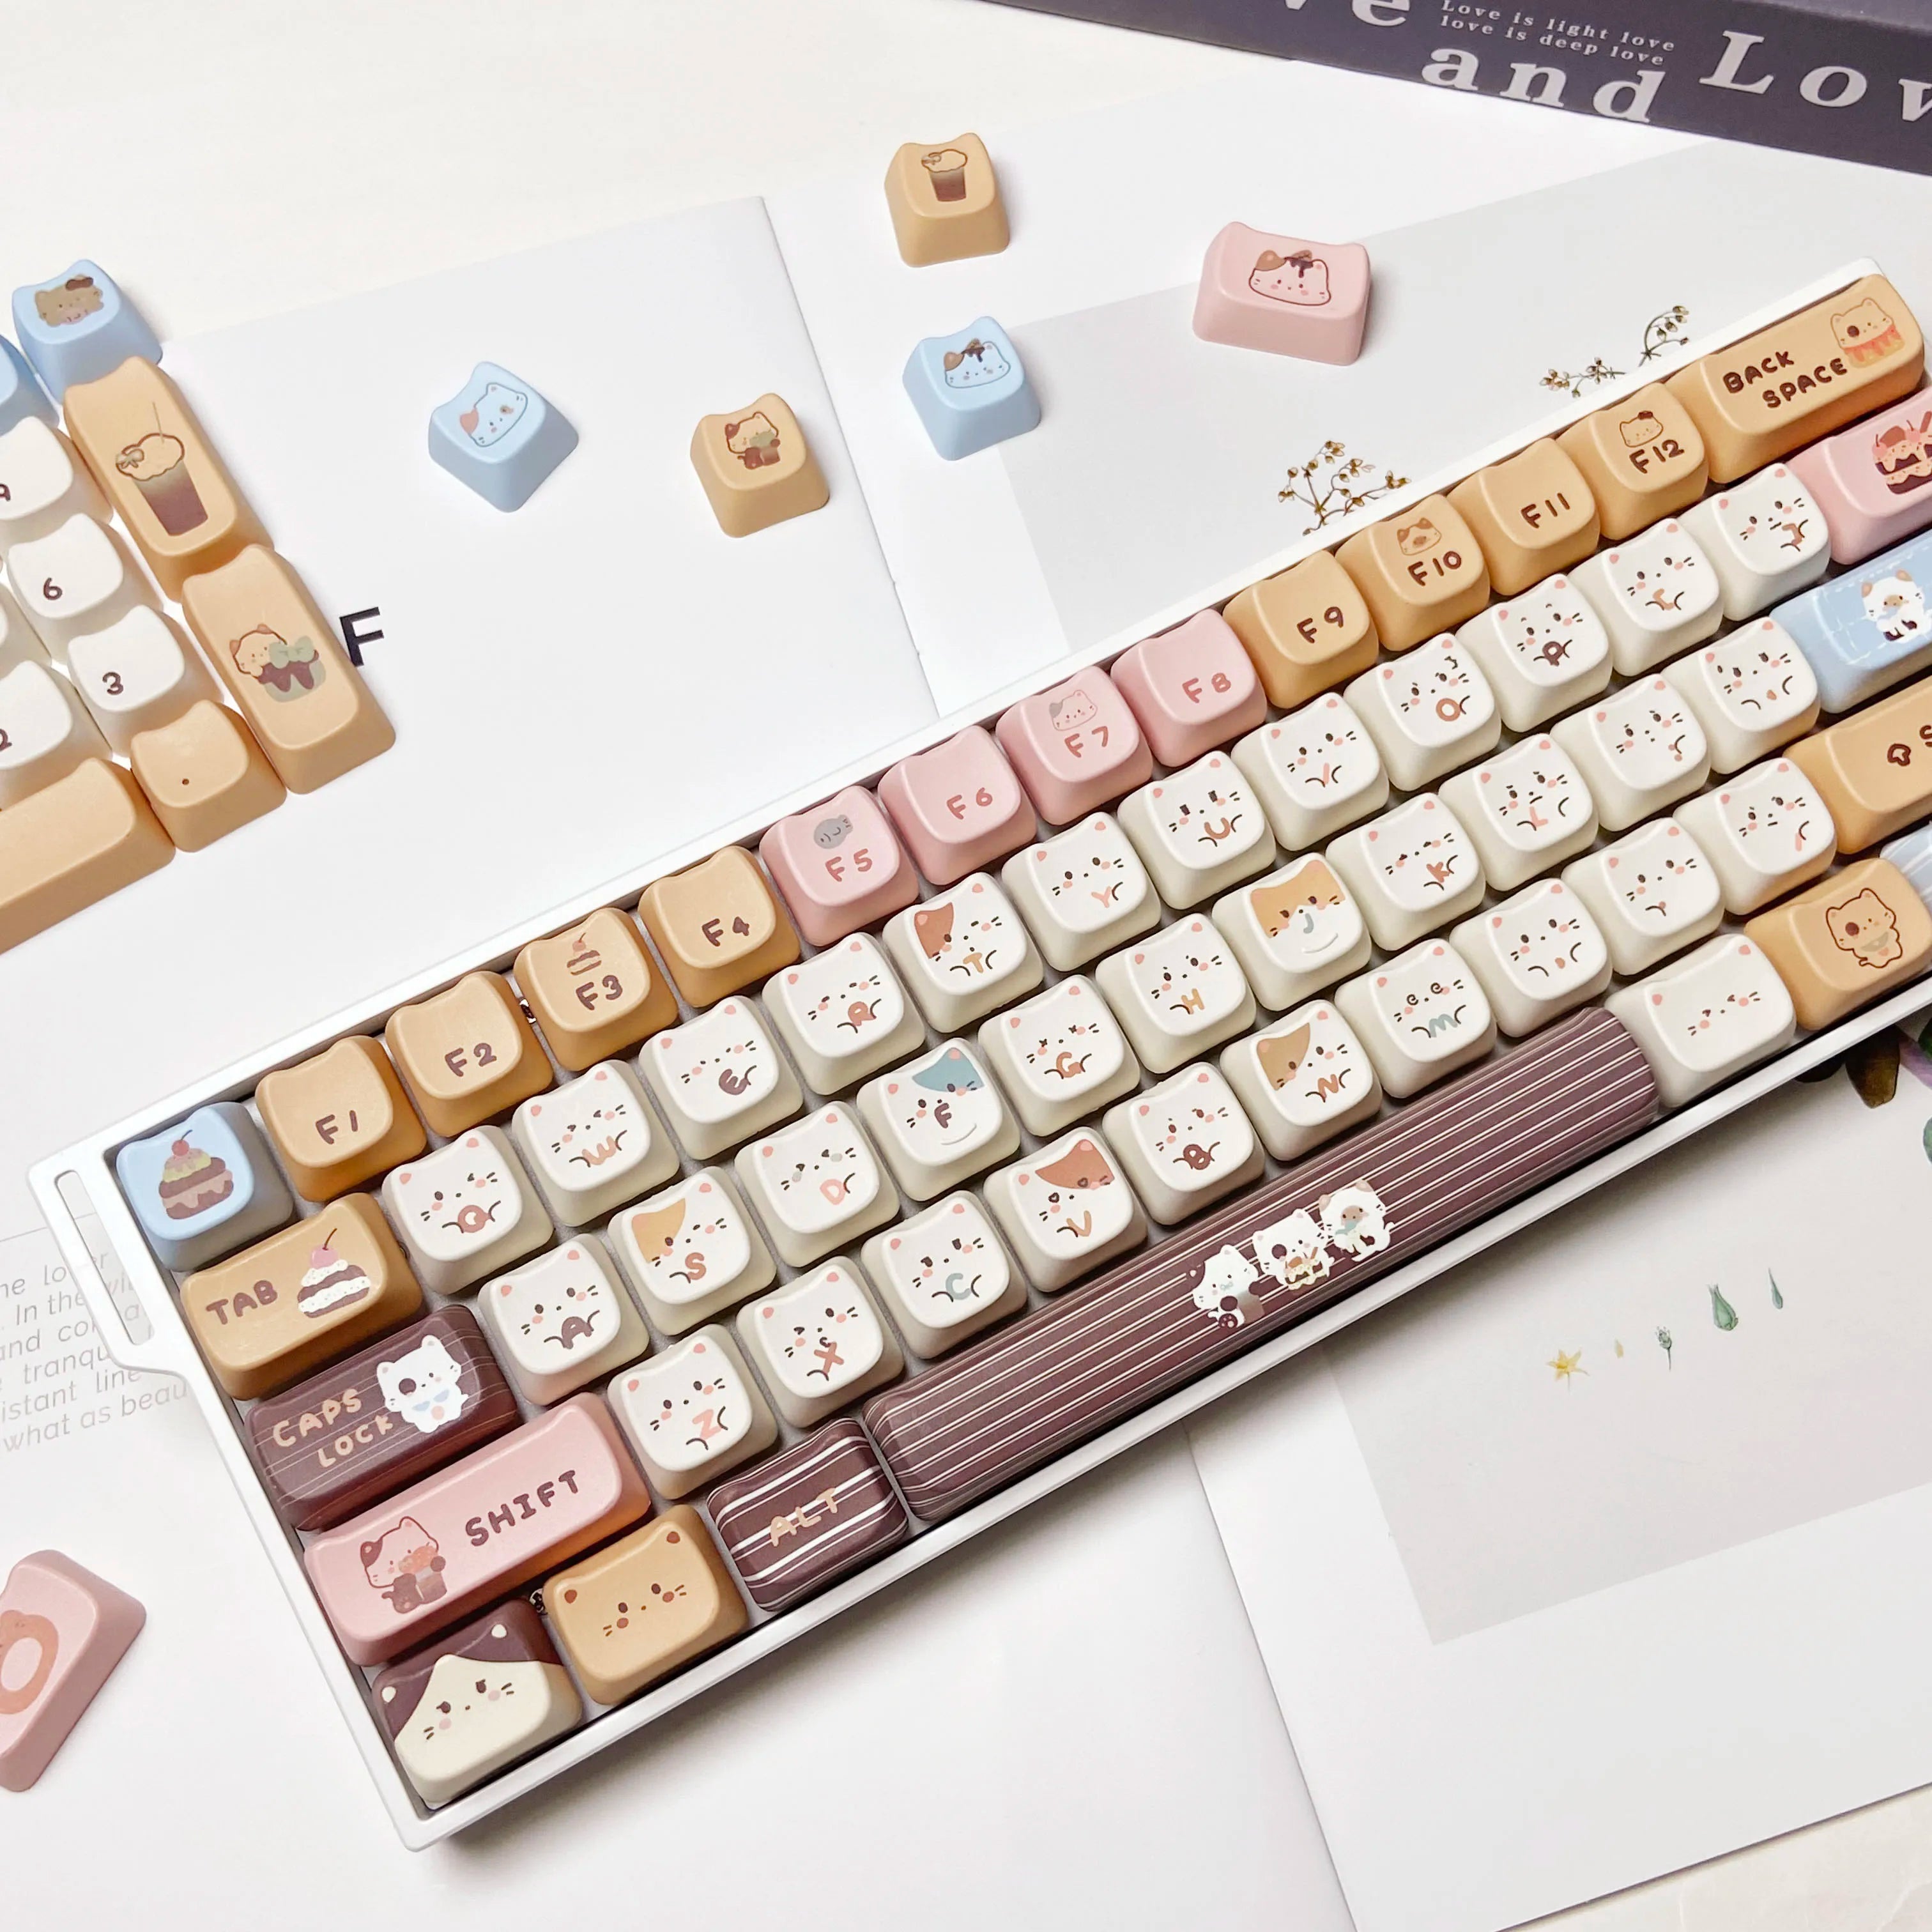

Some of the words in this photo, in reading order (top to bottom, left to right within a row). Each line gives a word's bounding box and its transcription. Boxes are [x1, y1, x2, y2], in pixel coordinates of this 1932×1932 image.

[1441, 0, 1500, 20] Love
[1513, 12, 1533, 26] is
[1546, 19, 1609, 40] light
[1621, 32, 1675, 51] love
[1441, 15, 1493, 34] love
[1505, 27, 1526, 41] is
[1540, 34, 1597, 56] deep
[1611, 46, 1664, 65] love
[1422, 49, 1665, 123] and
[1722, 351, 1794, 394] BACK
[1762, 358, 1848, 408] SPACE
[1629, 439, 1684, 474] F12
[1521, 493, 1570, 529] F11
[1407, 550, 1461, 586] F10
[43, 577, 63, 601] 6
[339, 606, 384, 667] F
[1297, 606, 1344, 643] F9
[1542, 640, 1564, 666] P
[102, 671, 124, 696] 3
[1182, 672, 1231, 703] F8
[1436, 697, 1461, 722] O
[1064, 725, 1108, 758] F7
[946, 787, 993, 820] F6
[1529, 805, 1549, 827] L
[1204, 817, 1231, 839] U
[825, 848, 873, 882] F5
[1426, 861, 1450, 883] K
[1091, 886, 1112, 908] Y
[702, 916, 749, 947] F4
[963, 952, 984, 974] T
[576, 975, 623, 1011] F3
[1180, 988, 1205, 1015] H
[848, 1000, 876, 1026] R
[445, 1042, 497, 1077] F2
[1055, 1051, 1082, 1078] G
[719, 1068, 749, 1095] E
[1317, 1073, 1340, 1100] N
[316, 1109, 358, 1145] F1
[934, 1102, 952, 1129] F
[581, 1135, 618, 1165] W
[1183, 1144, 1212, 1170] B
[820, 1178, 846, 1205] D
[457, 1204, 491, 1233] Q
[1066, 1209, 1092, 1238] V
[684, 1252, 707, 1280] S
[945, 1272, 972, 1301] C
[206, 1280, 278, 1325] TAB
[561, 1316, 594, 1350] A
[813, 1342, 845, 1375] X
[4, 1414, 70, 1452] what
[80, 1406, 111, 1429] as
[273, 1388, 362, 1447] CAPS
[692, 1409, 722, 1439] Z
[318, 1415, 393, 1468] LOCK
[465, 1470, 579, 1547] SHIFT
[770, 1487, 838, 1547] ALT
